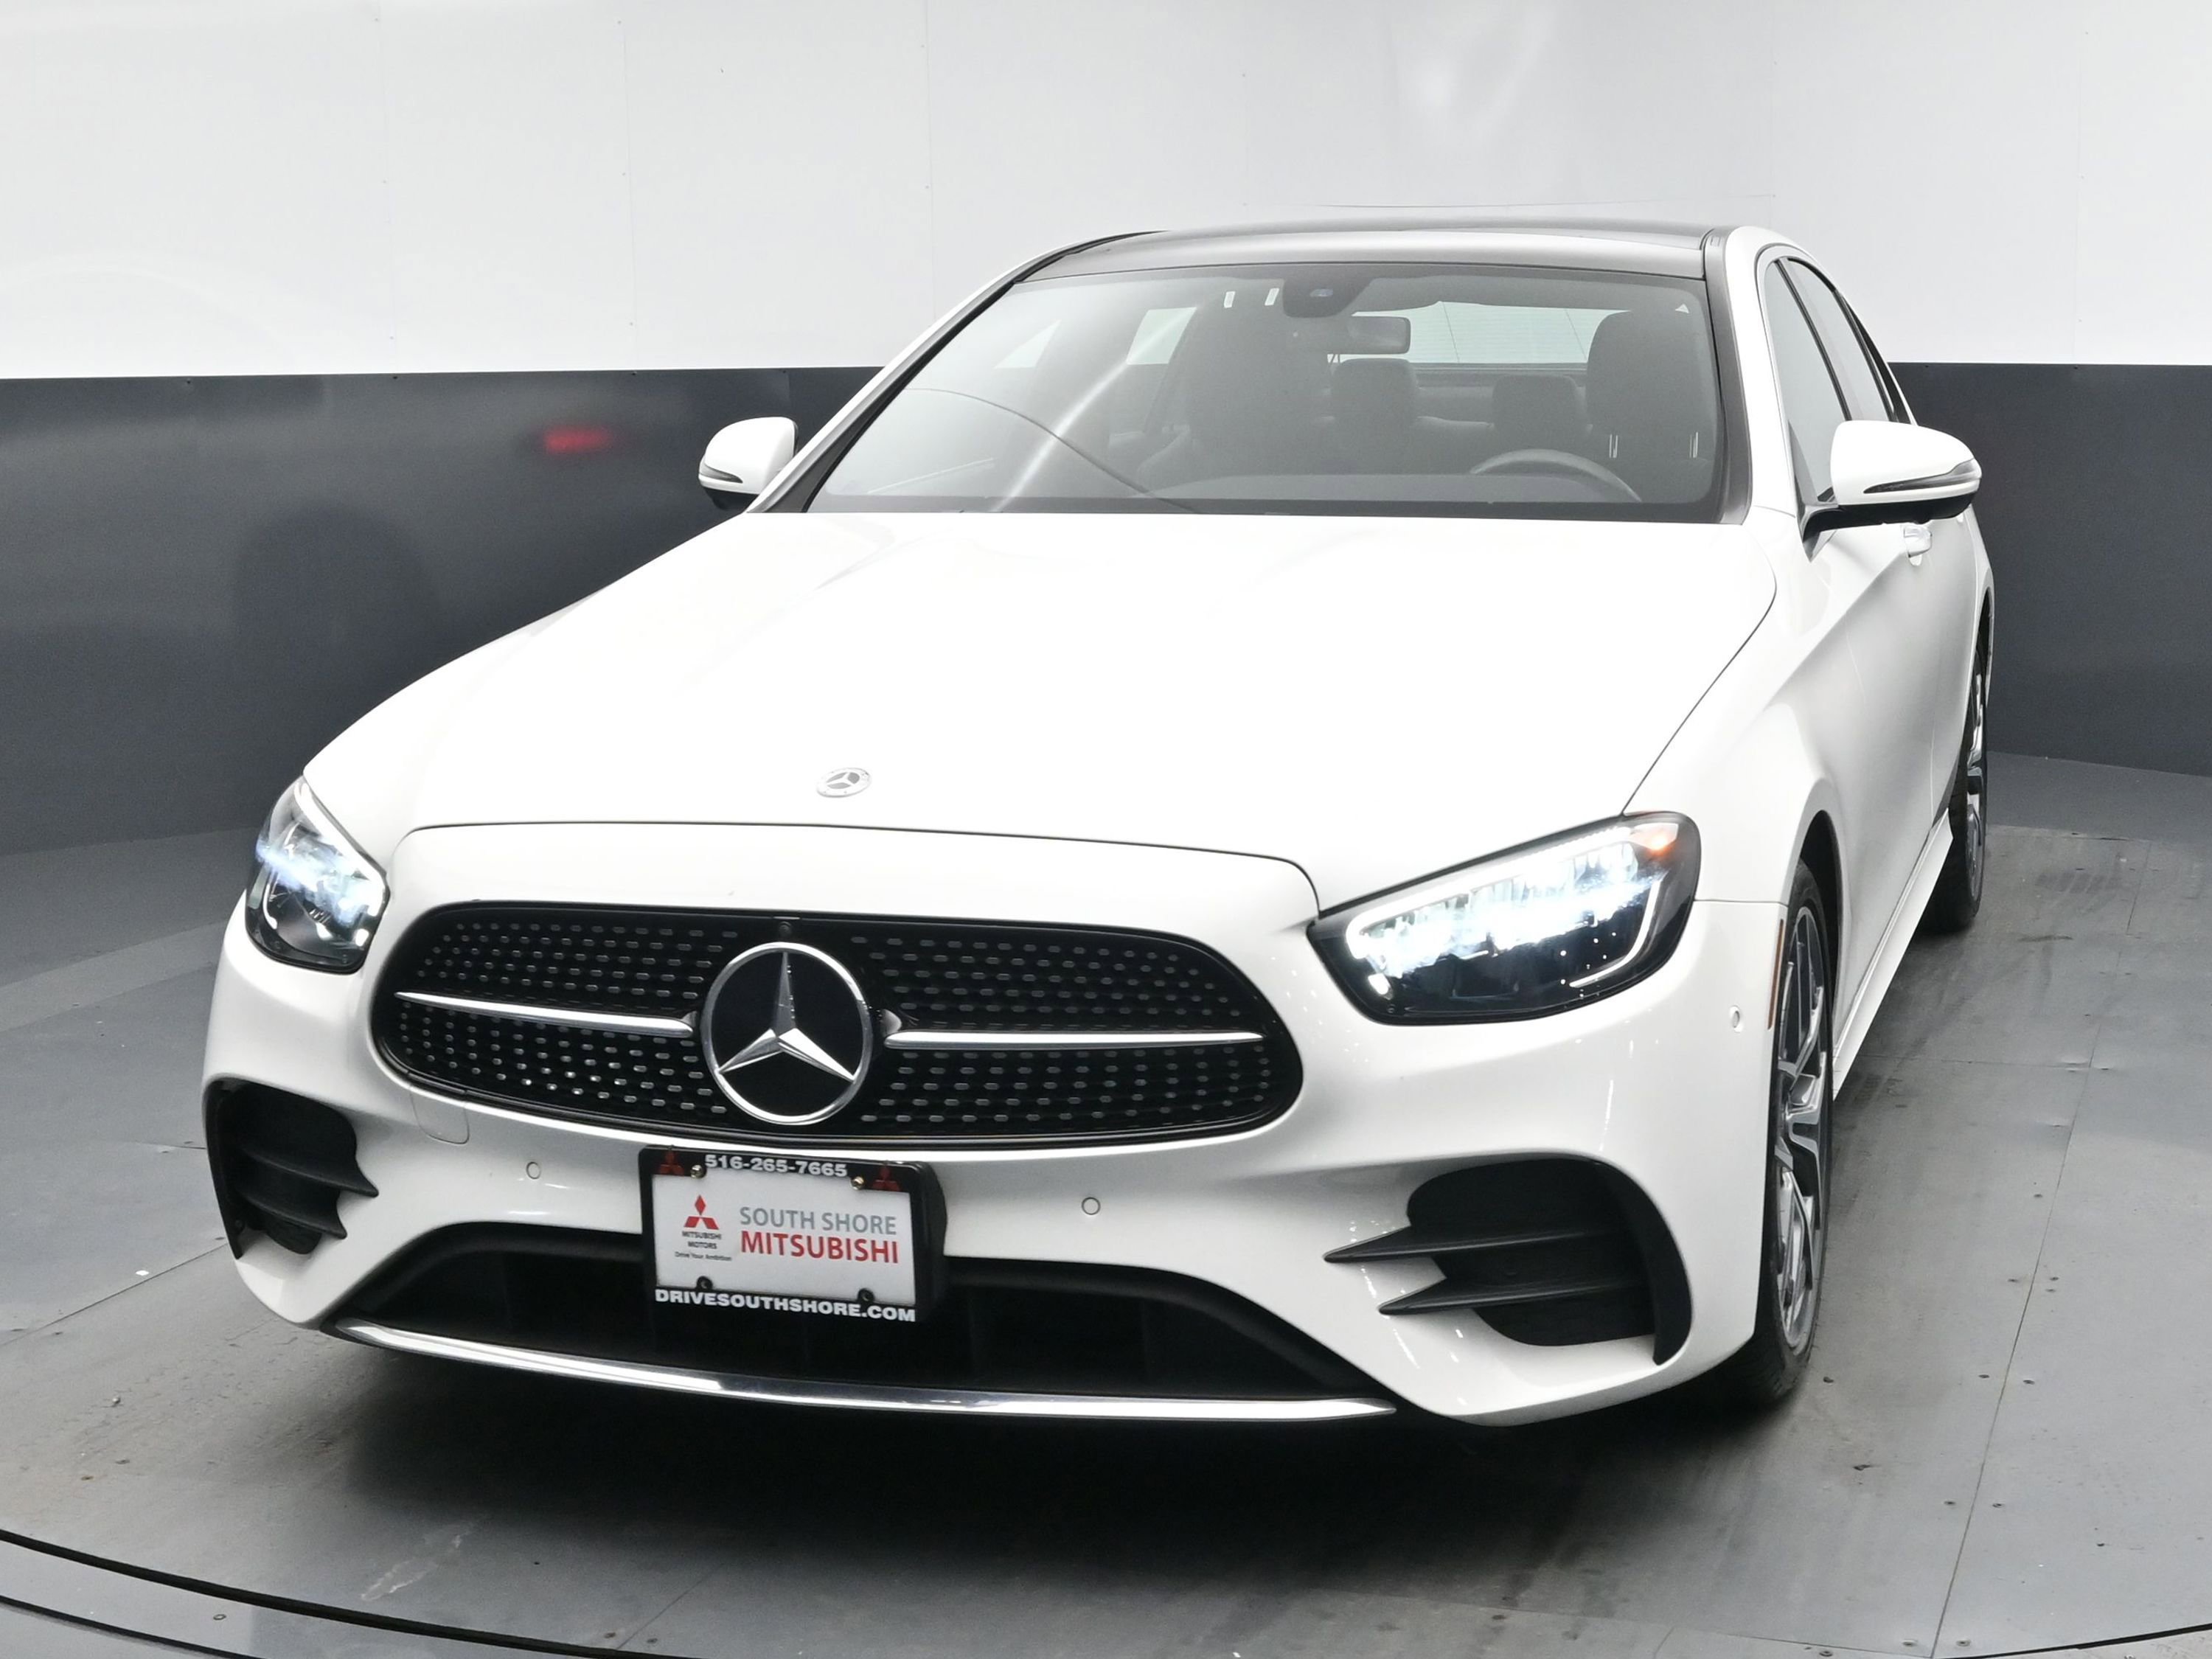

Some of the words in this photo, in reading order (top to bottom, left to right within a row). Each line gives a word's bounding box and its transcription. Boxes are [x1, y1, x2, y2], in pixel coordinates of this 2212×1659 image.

[705, 1154, 848, 1178] 516-265-7665
[740, 1206, 815, 1230] SOUTH
[821, 1211, 897, 1235] SHORE
[682, 1231, 722, 1240] MITSUBISHI
[687, 1241, 717, 1250] MOTORS
[741, 1230, 899, 1264] MITSUBISHI
[655, 1288, 916, 1322] DRIVESOUTHSHORE.COM
